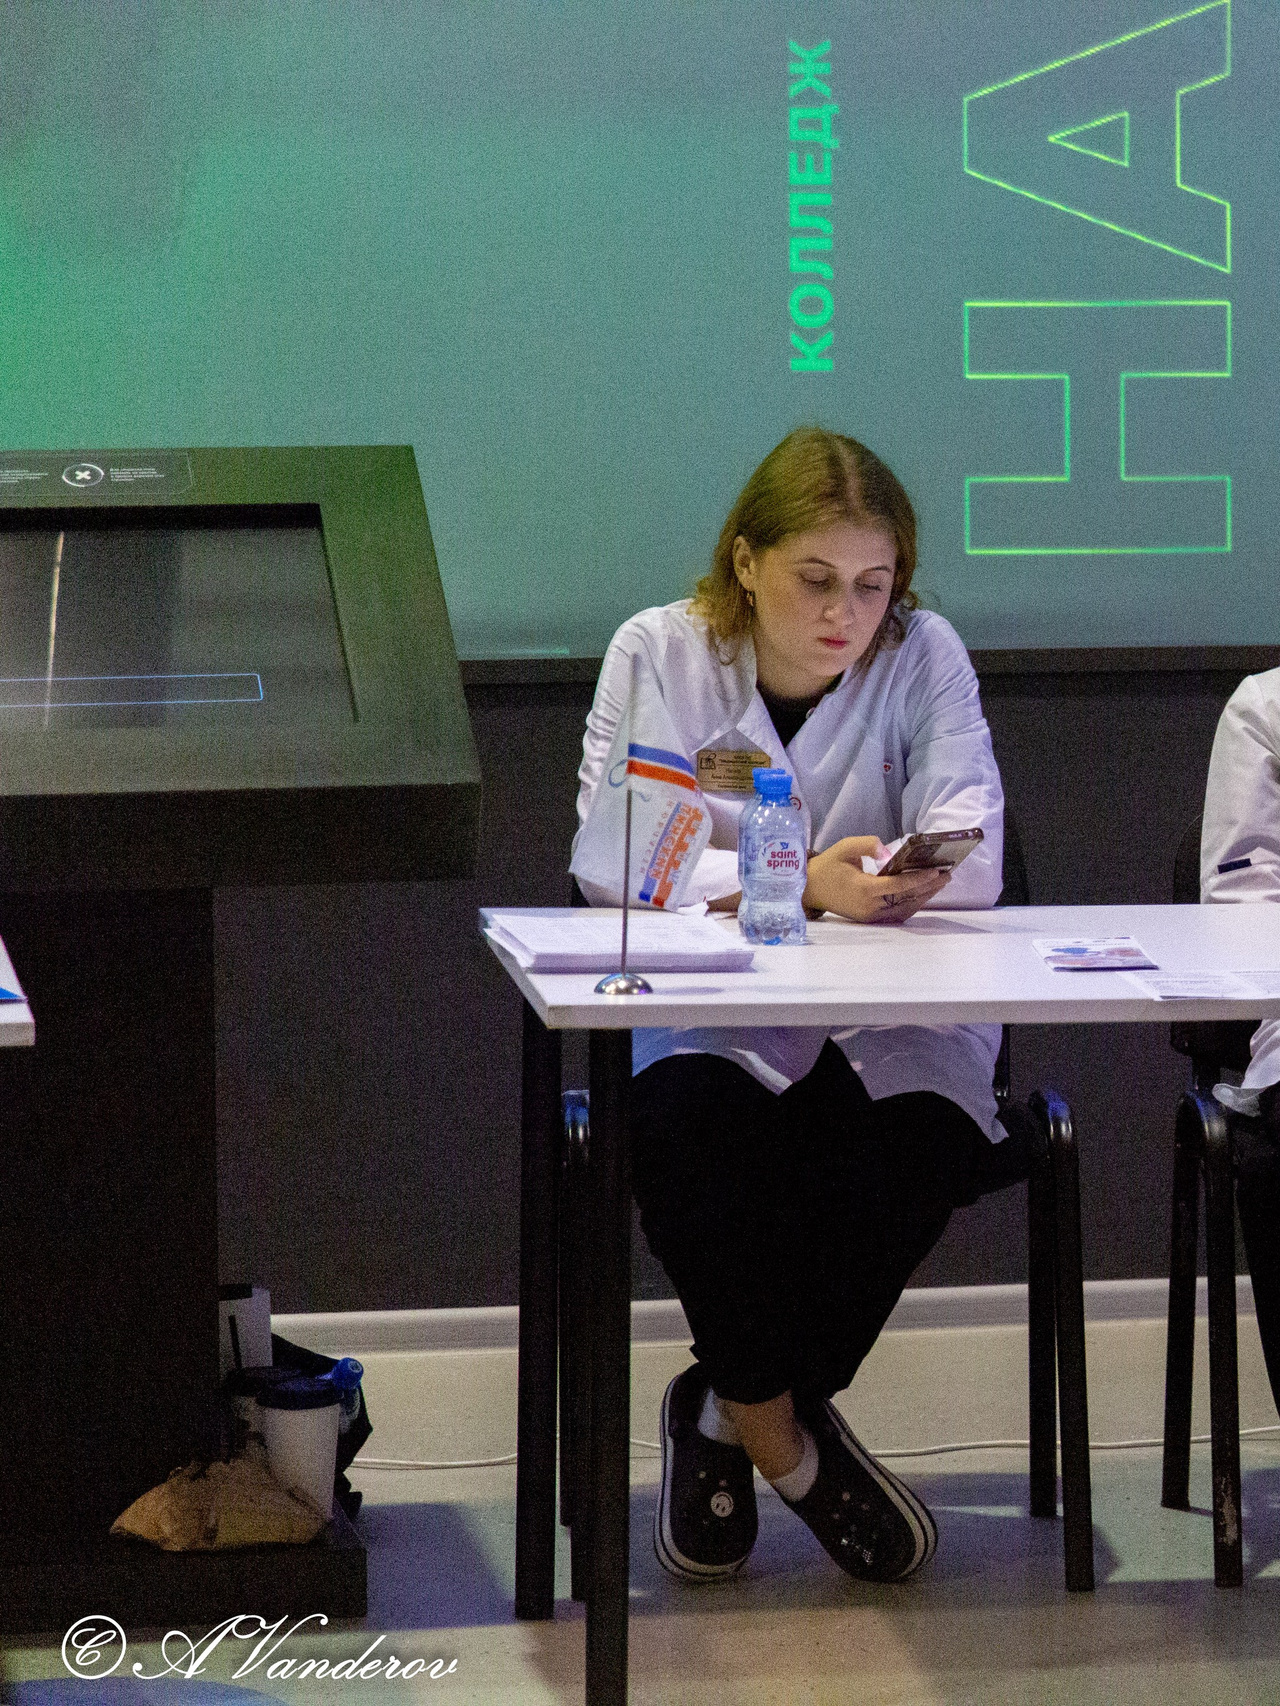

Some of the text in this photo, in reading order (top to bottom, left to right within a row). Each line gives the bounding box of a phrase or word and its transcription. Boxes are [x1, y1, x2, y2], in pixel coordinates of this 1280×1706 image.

[788, 40, 839, 372] КОЛЛЕДЖ
[770, 849, 798, 860] saint
[766, 858, 801, 872] spring
